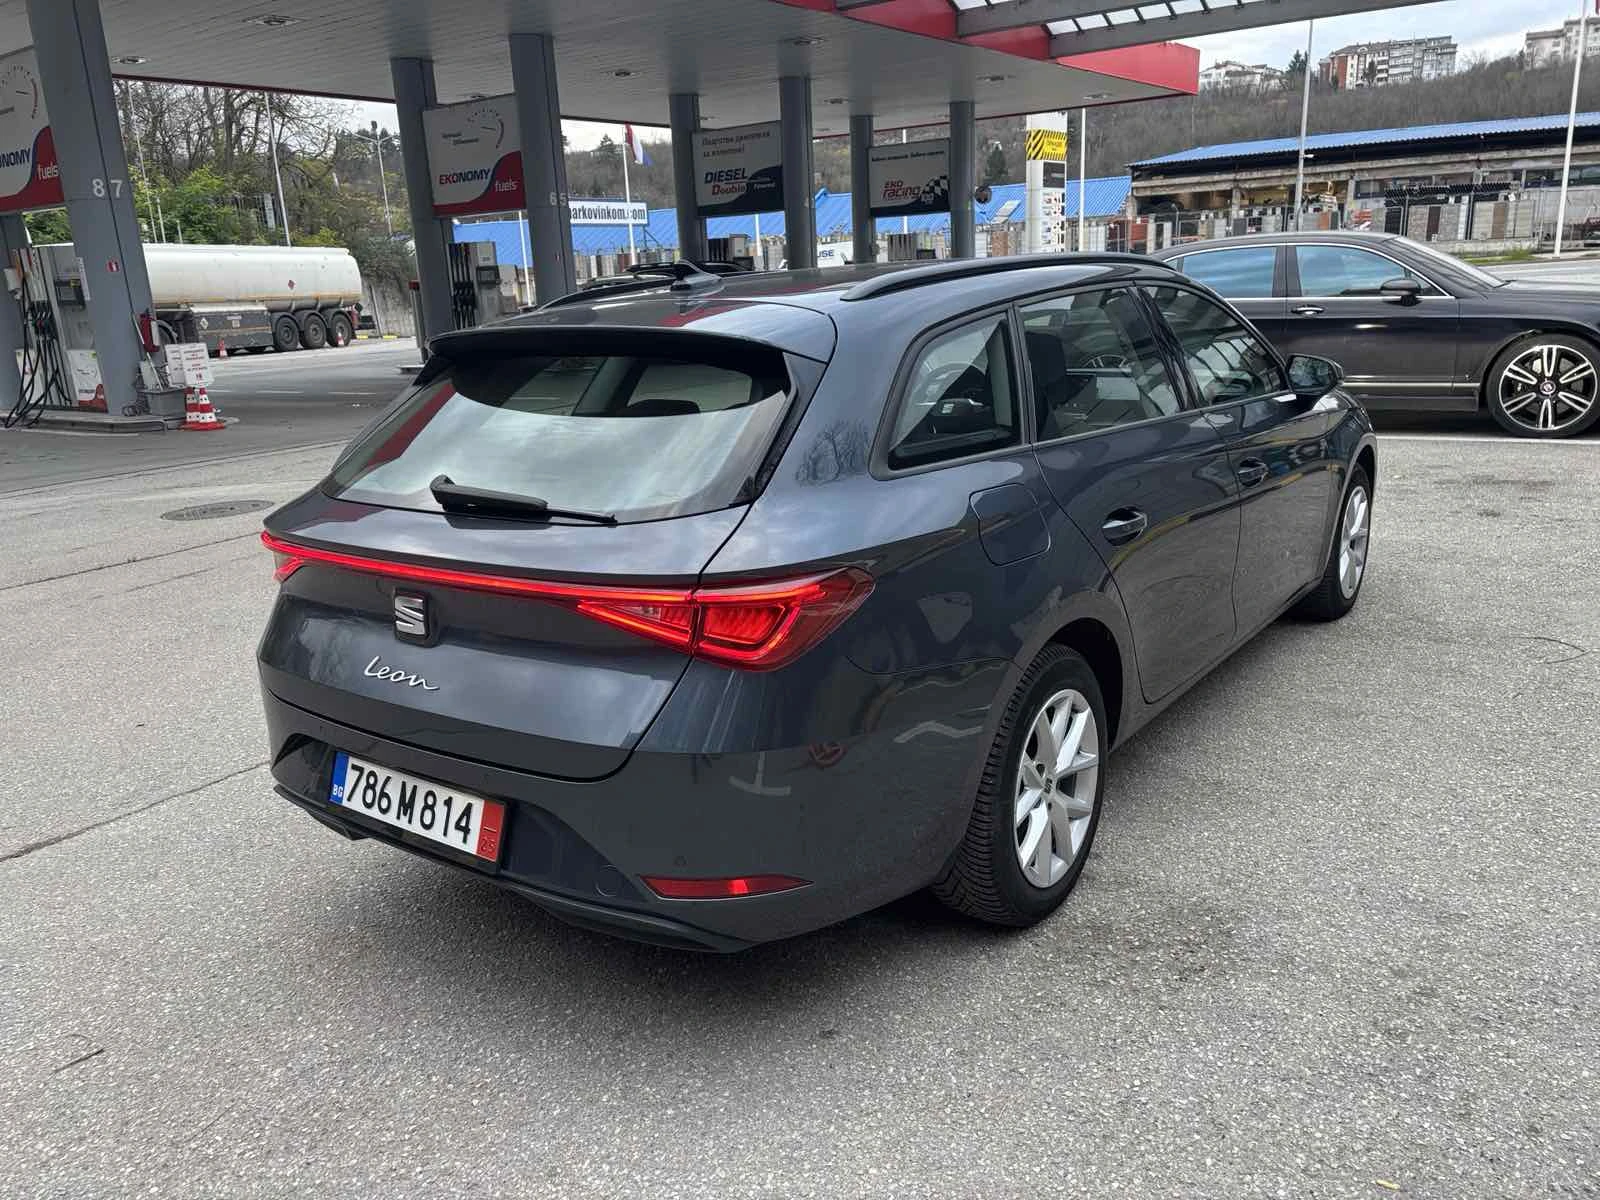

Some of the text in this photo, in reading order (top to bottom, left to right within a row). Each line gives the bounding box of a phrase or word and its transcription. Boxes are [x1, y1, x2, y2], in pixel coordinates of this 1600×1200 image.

[0, 148, 31, 168] NOMY
[439, 167, 491, 185] EKONOMY
[704, 168, 748, 184] DIESEL
[494, 177, 519, 193] fuels
[882, 185, 921, 200] racing
[364, 655, 440, 690] Leon
[332, 783, 344, 797] BG
